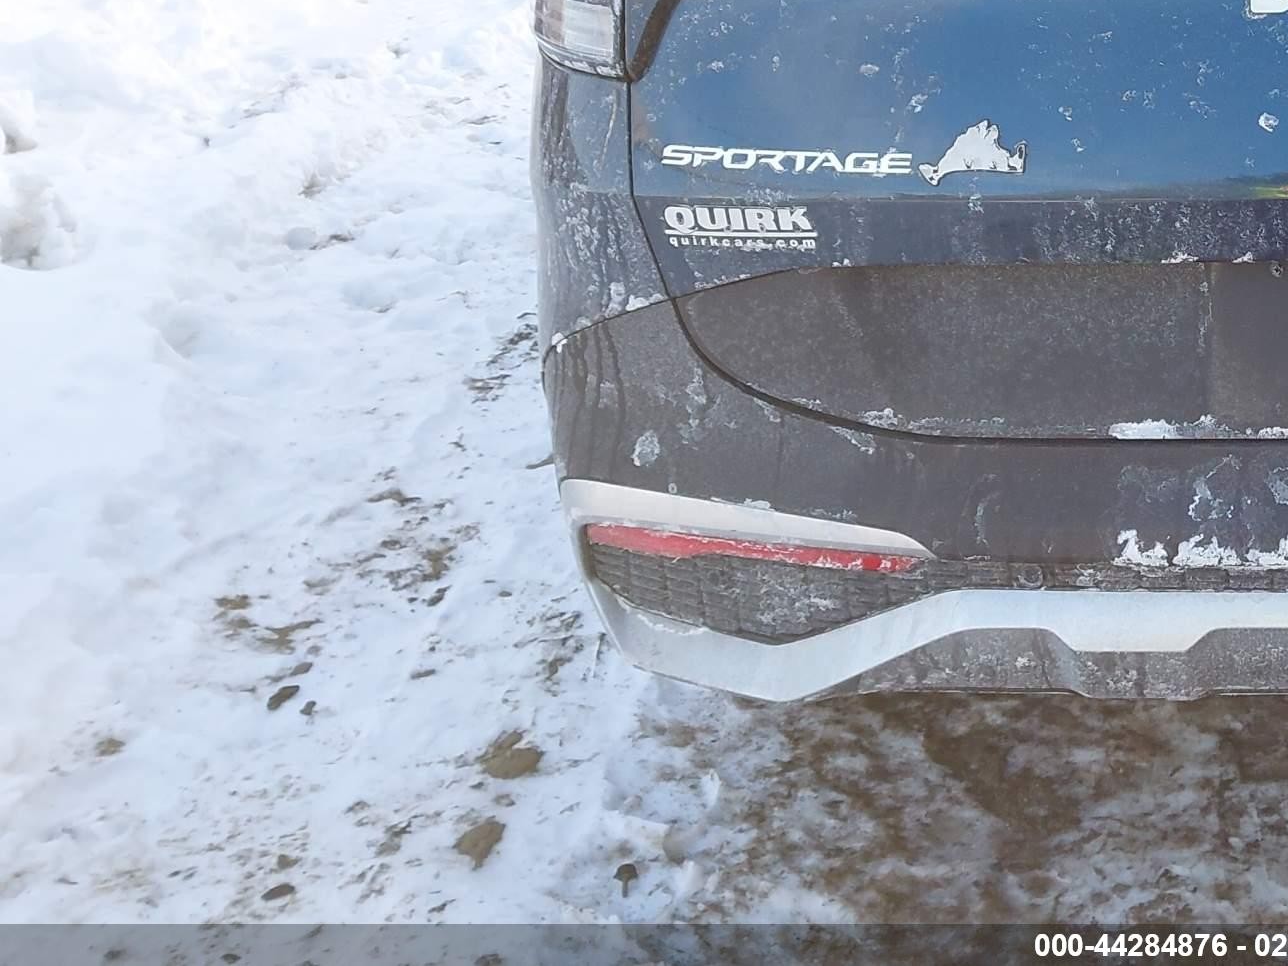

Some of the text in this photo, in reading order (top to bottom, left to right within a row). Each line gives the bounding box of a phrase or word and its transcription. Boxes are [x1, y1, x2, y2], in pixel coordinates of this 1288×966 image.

[661, 143, 913, 175] SPORTAGE
[664, 206, 813, 233] QUIRK
[668, 236, 816, 250] quirkcars.com
